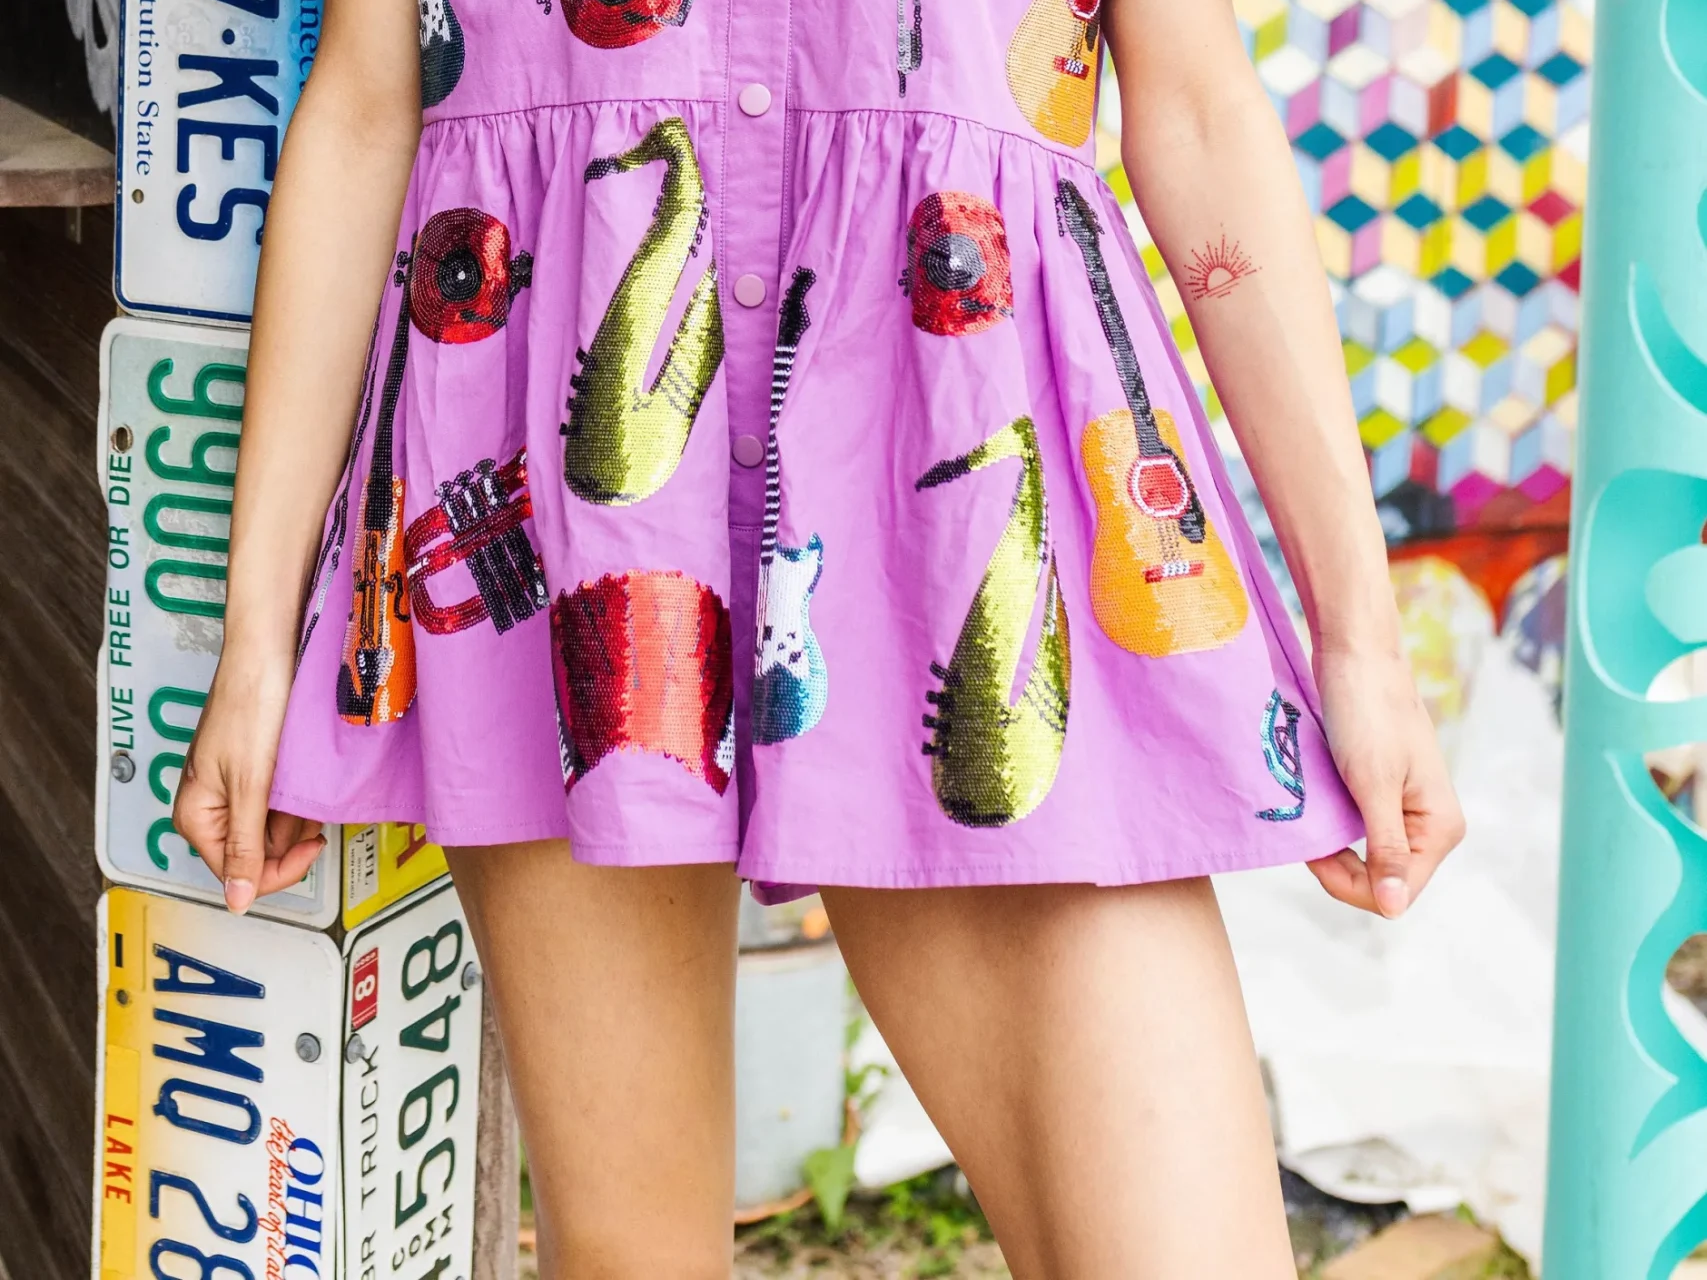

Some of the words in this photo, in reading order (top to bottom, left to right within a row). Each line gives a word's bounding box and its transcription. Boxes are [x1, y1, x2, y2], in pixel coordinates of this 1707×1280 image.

[136, 100, 160, 176] State
[108, 454, 133, 506] DIE
[108, 524, 130, 570] OR
[109, 587, 133, 668] FREE
[111, 686, 134, 750] LIVE
[355, 974, 375, 1001] 8
[152, 943, 265, 1145] AMQ
[266, 1117, 296, 1154] the
[361, 1045, 379, 1210] TRUCK
[105, 1114, 134, 1205] LAKE
[268, 1156, 296, 1213] heart
[257, 1211, 286, 1239] of
